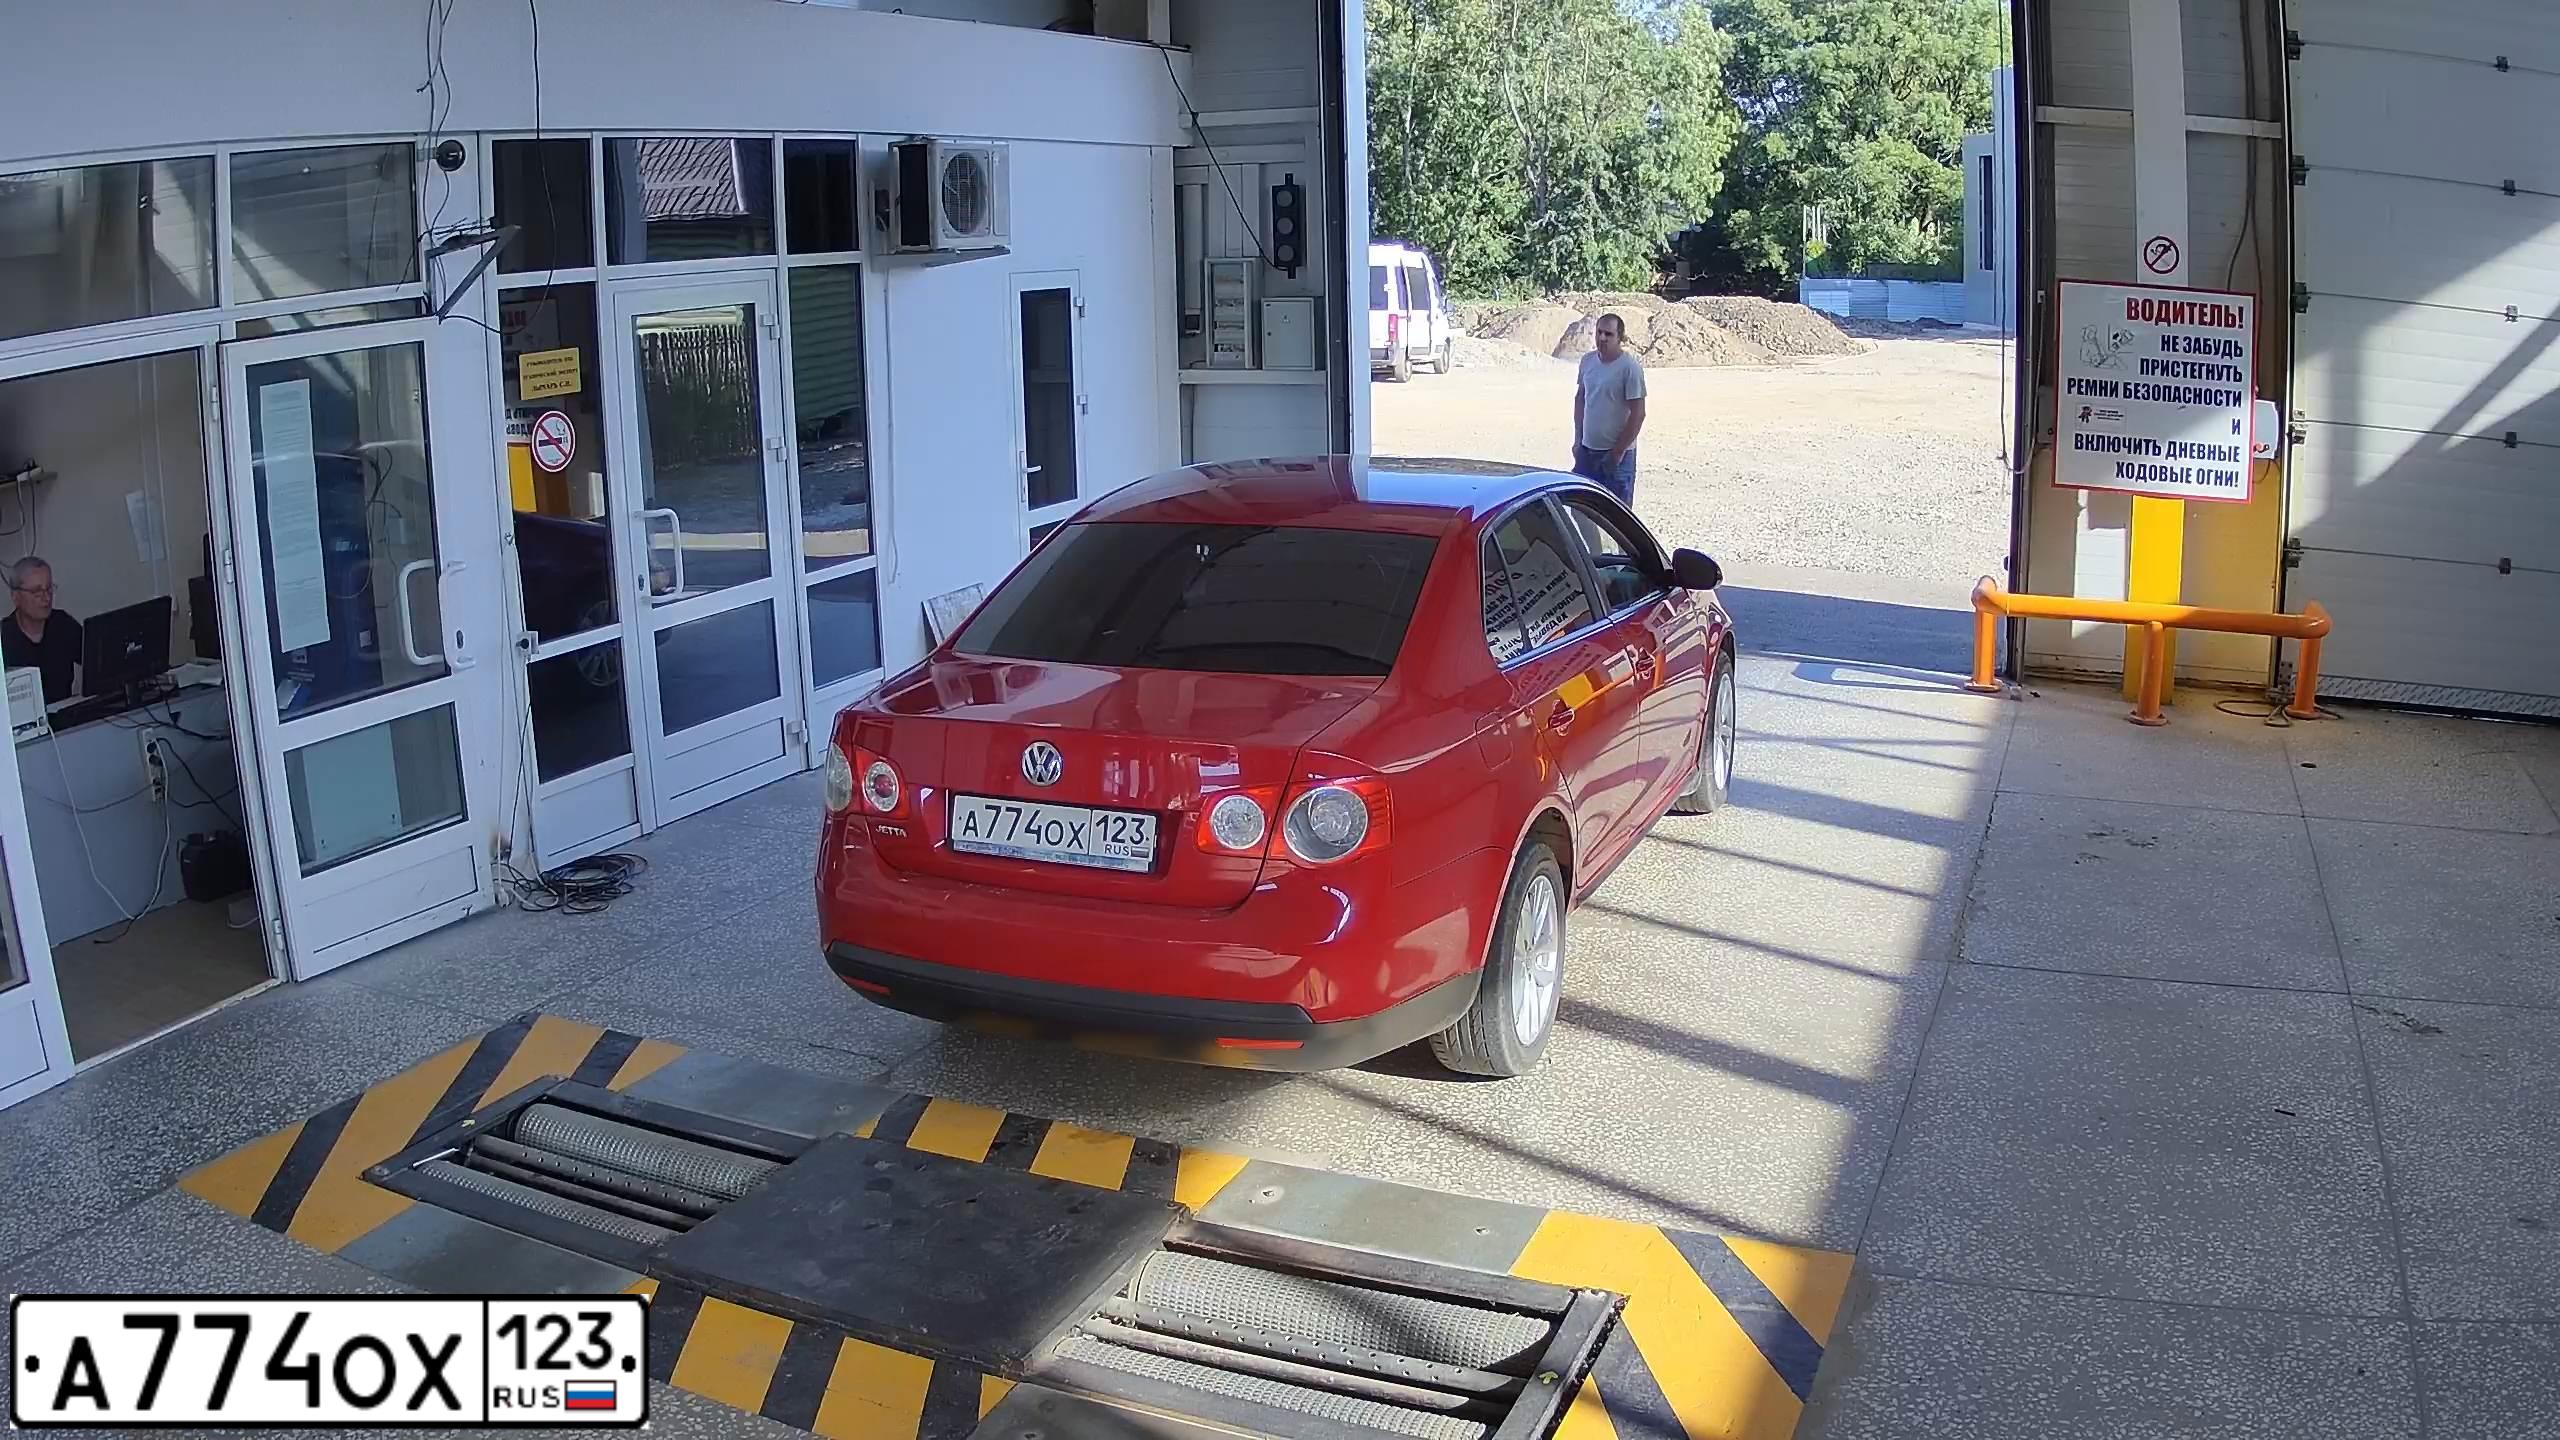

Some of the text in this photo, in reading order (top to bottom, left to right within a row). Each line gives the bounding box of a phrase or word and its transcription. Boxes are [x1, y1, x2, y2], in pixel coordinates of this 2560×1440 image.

[2126, 297, 2244, 329] ВОДИТЕЛЬ!
[2160, 334, 2244, 360] НЕ ЗАБУДЬ
[2140, 358, 2243, 383] ПРИСТЕГНУТЬ
[2067, 377, 2242, 408] РЕМНИ БЕЗОПАСНОСТИ
[2231, 418, 2241, 436] И
[2074, 432, 2241, 463] ВКЛЮЧИТЬ ДНЕВНЫЕ
[2115, 461, 2239, 487] ХОДОВЫЕ ОГНИ!
[875, 824, 908, 839] JETTA
[962, 804, 1146, 850] А774ОХ 123
[1104, 844, 1130, 857] RUS
